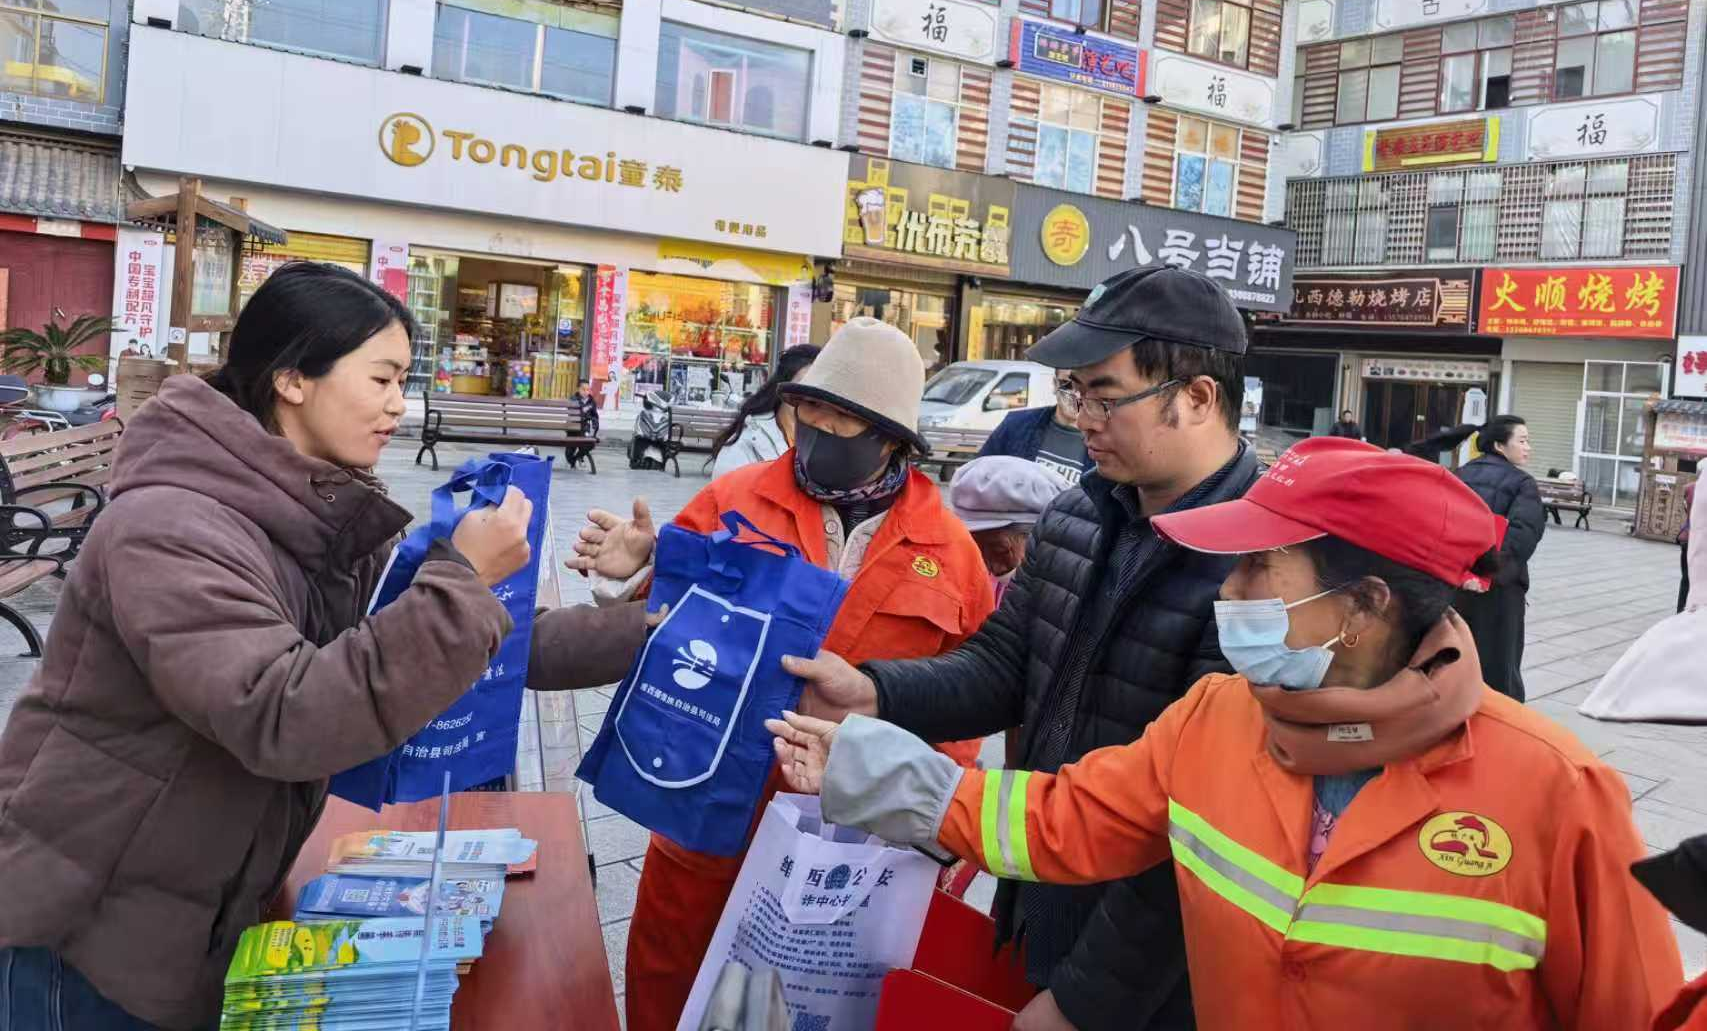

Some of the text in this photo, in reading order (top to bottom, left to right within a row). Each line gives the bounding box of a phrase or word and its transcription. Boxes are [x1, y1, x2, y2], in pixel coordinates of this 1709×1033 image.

[921, 3, 948, 42] 福
[1207, 75, 1227, 108] 福
[1577, 113, 1607, 147] 福
[443, 129, 684, 193] Tongtai 童泰
[1108, 224, 1285, 290] 八号当铺
[1488, 271, 1666, 317] 火顺烧烤
